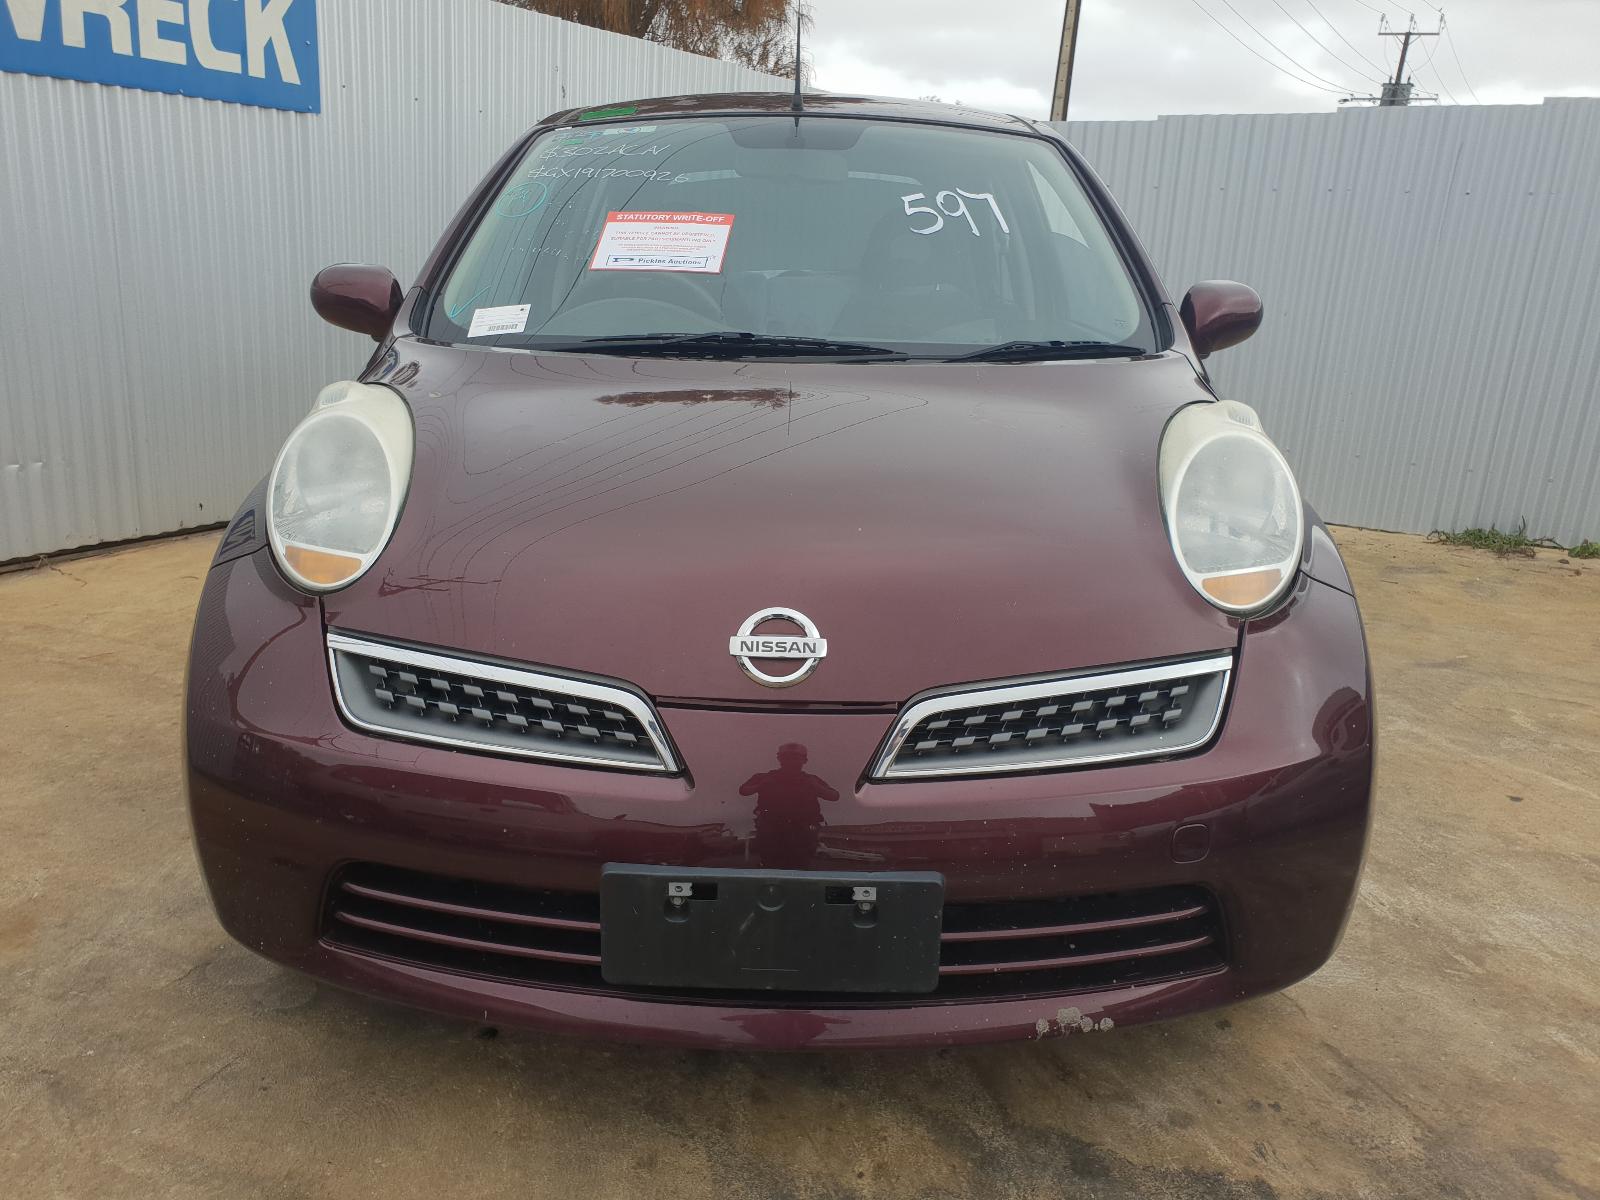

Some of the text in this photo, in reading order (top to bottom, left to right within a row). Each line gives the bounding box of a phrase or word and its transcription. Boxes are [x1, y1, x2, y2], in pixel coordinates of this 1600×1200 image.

[616, 213, 726, 223] STATUTORY WRITE-OFF
[900, 187, 1010, 237] 597
[667, 258, 702, 266] Auctions
[740, 640, 817, 654] NISSAN
